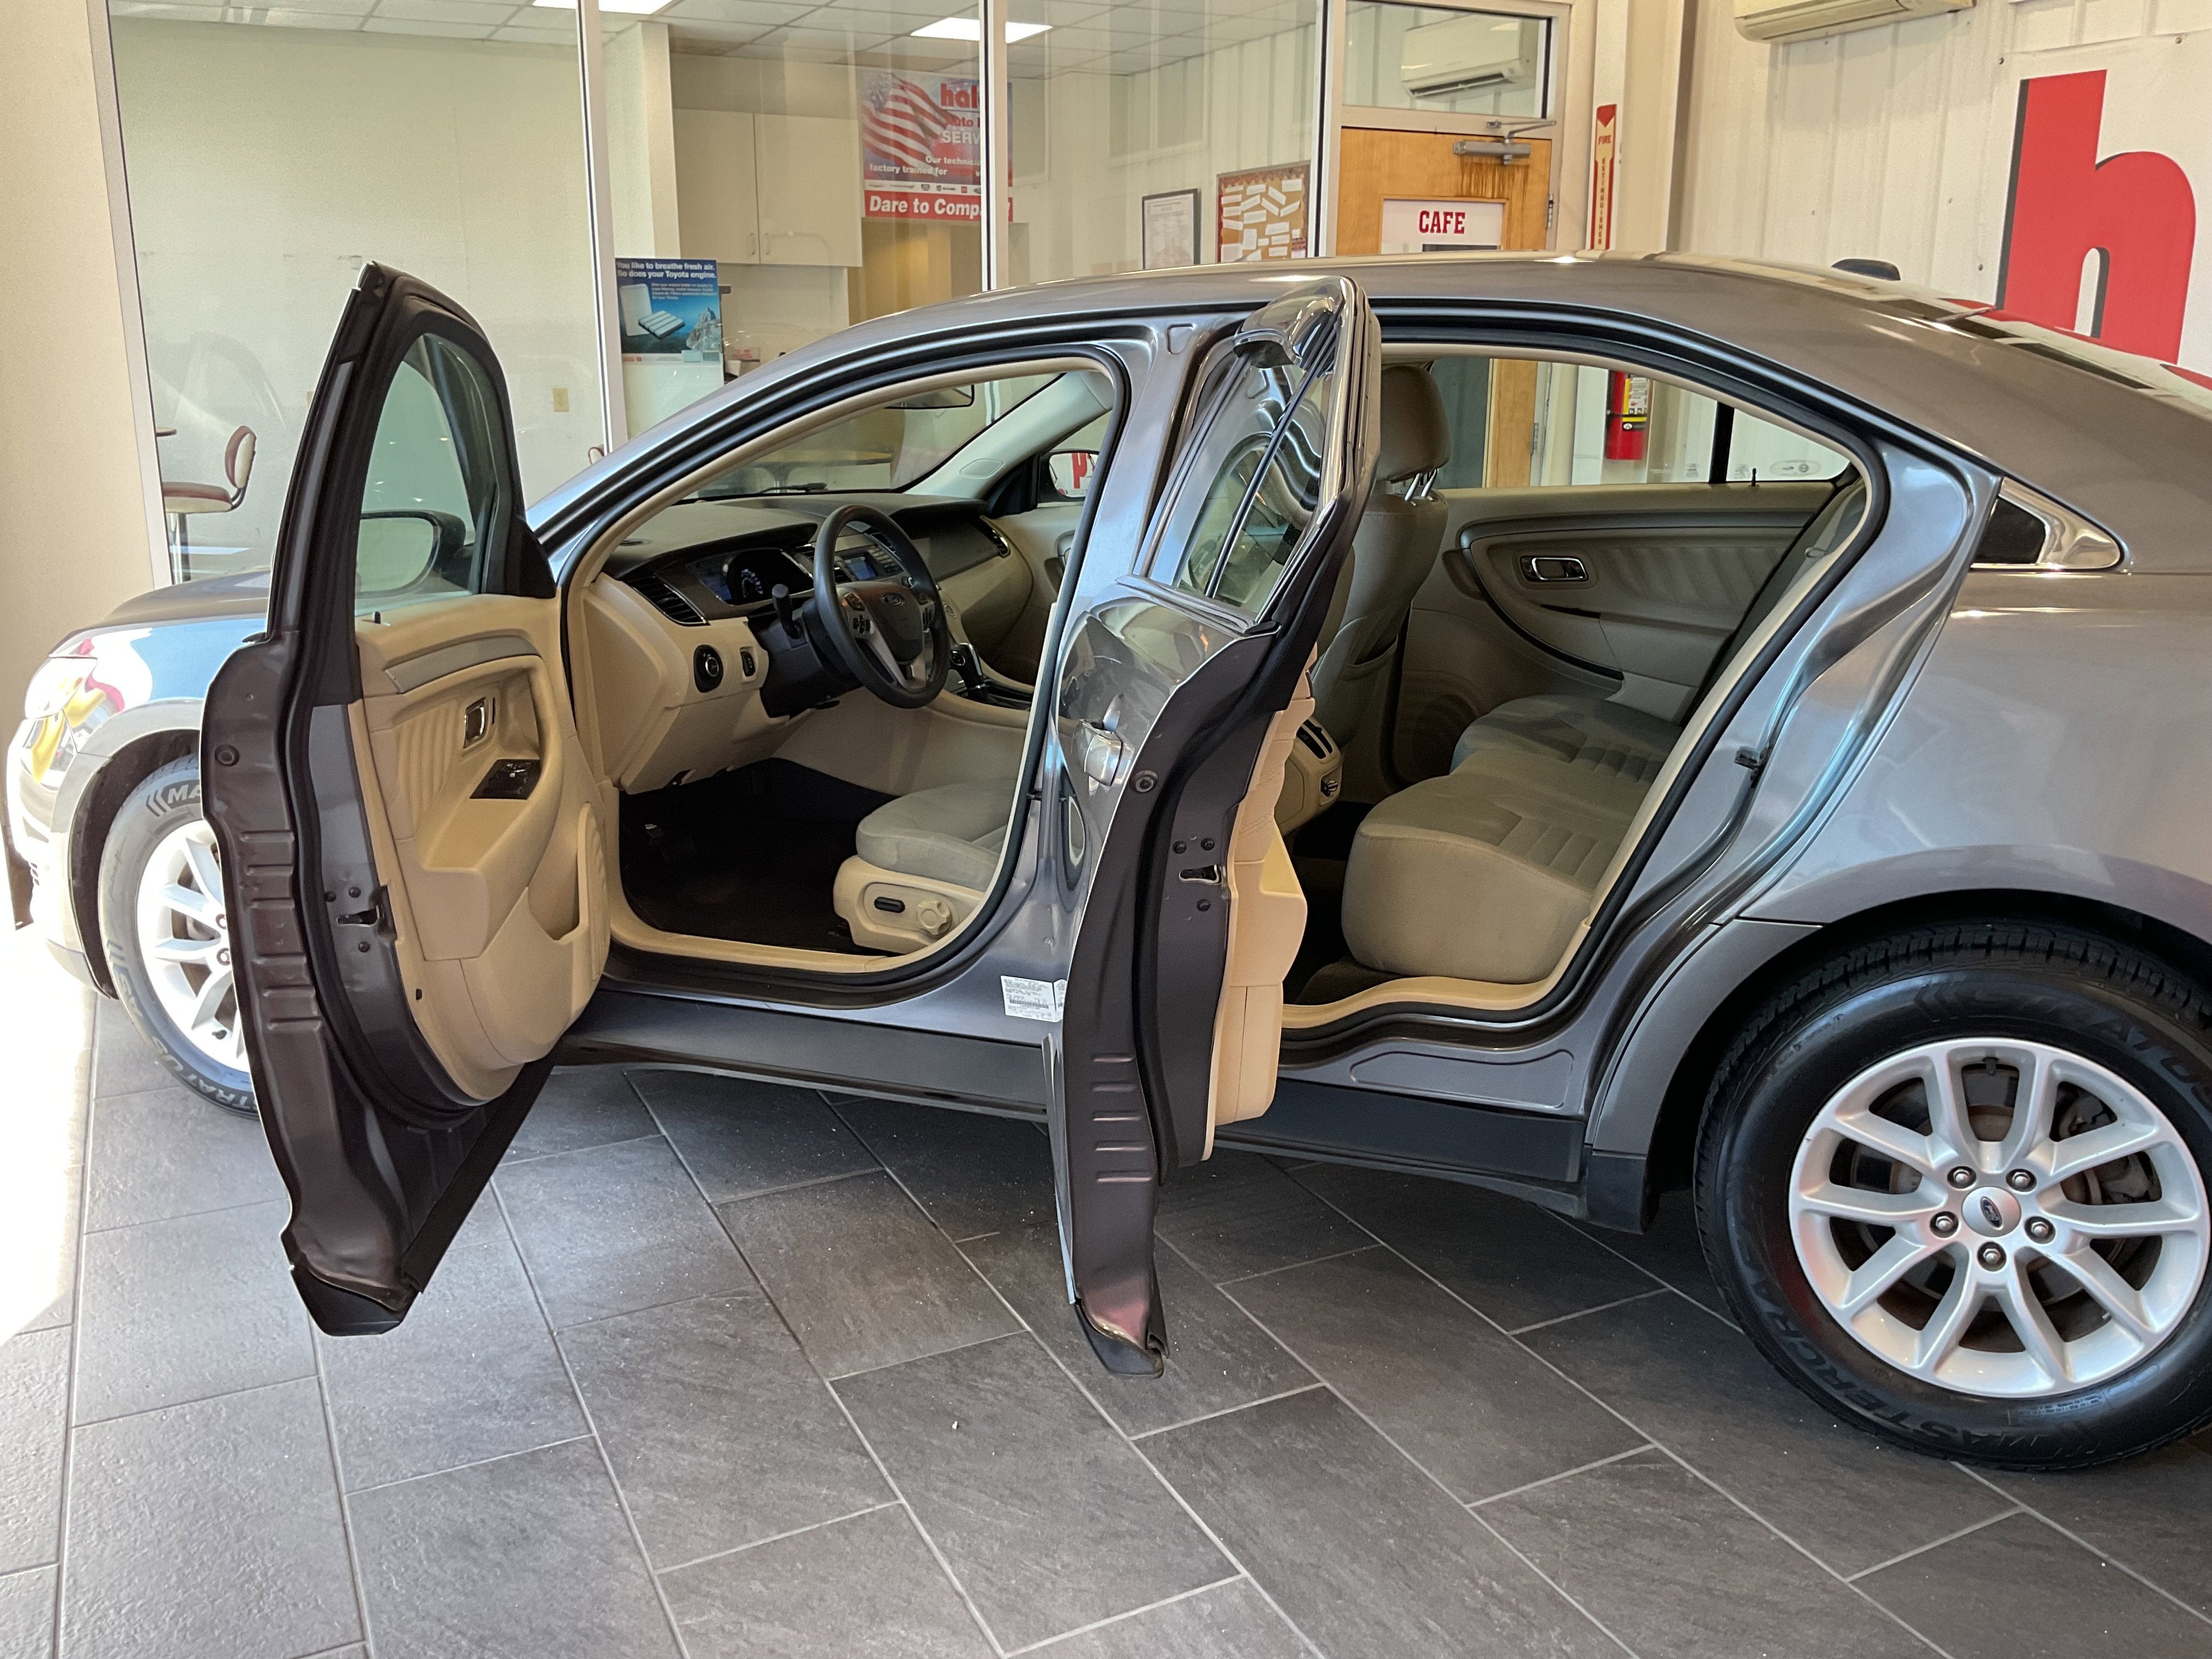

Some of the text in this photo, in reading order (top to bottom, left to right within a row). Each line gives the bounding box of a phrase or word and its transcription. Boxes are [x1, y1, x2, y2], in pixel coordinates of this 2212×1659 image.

[941, 83, 980, 109] hal
[942, 129, 980, 144] SERV
[1598, 135, 1611, 145] FIRE
[926, 156, 942, 164] Our
[869, 163, 948, 177] factory trained for
[869, 195, 981, 219] Dare to Comp
[1598, 157, 1606, 245] EXTINGUISHER
[1419, 210, 1466, 234] CAFE
[665, 270, 690, 279] Toyota
[167, 784, 201, 804] MA
